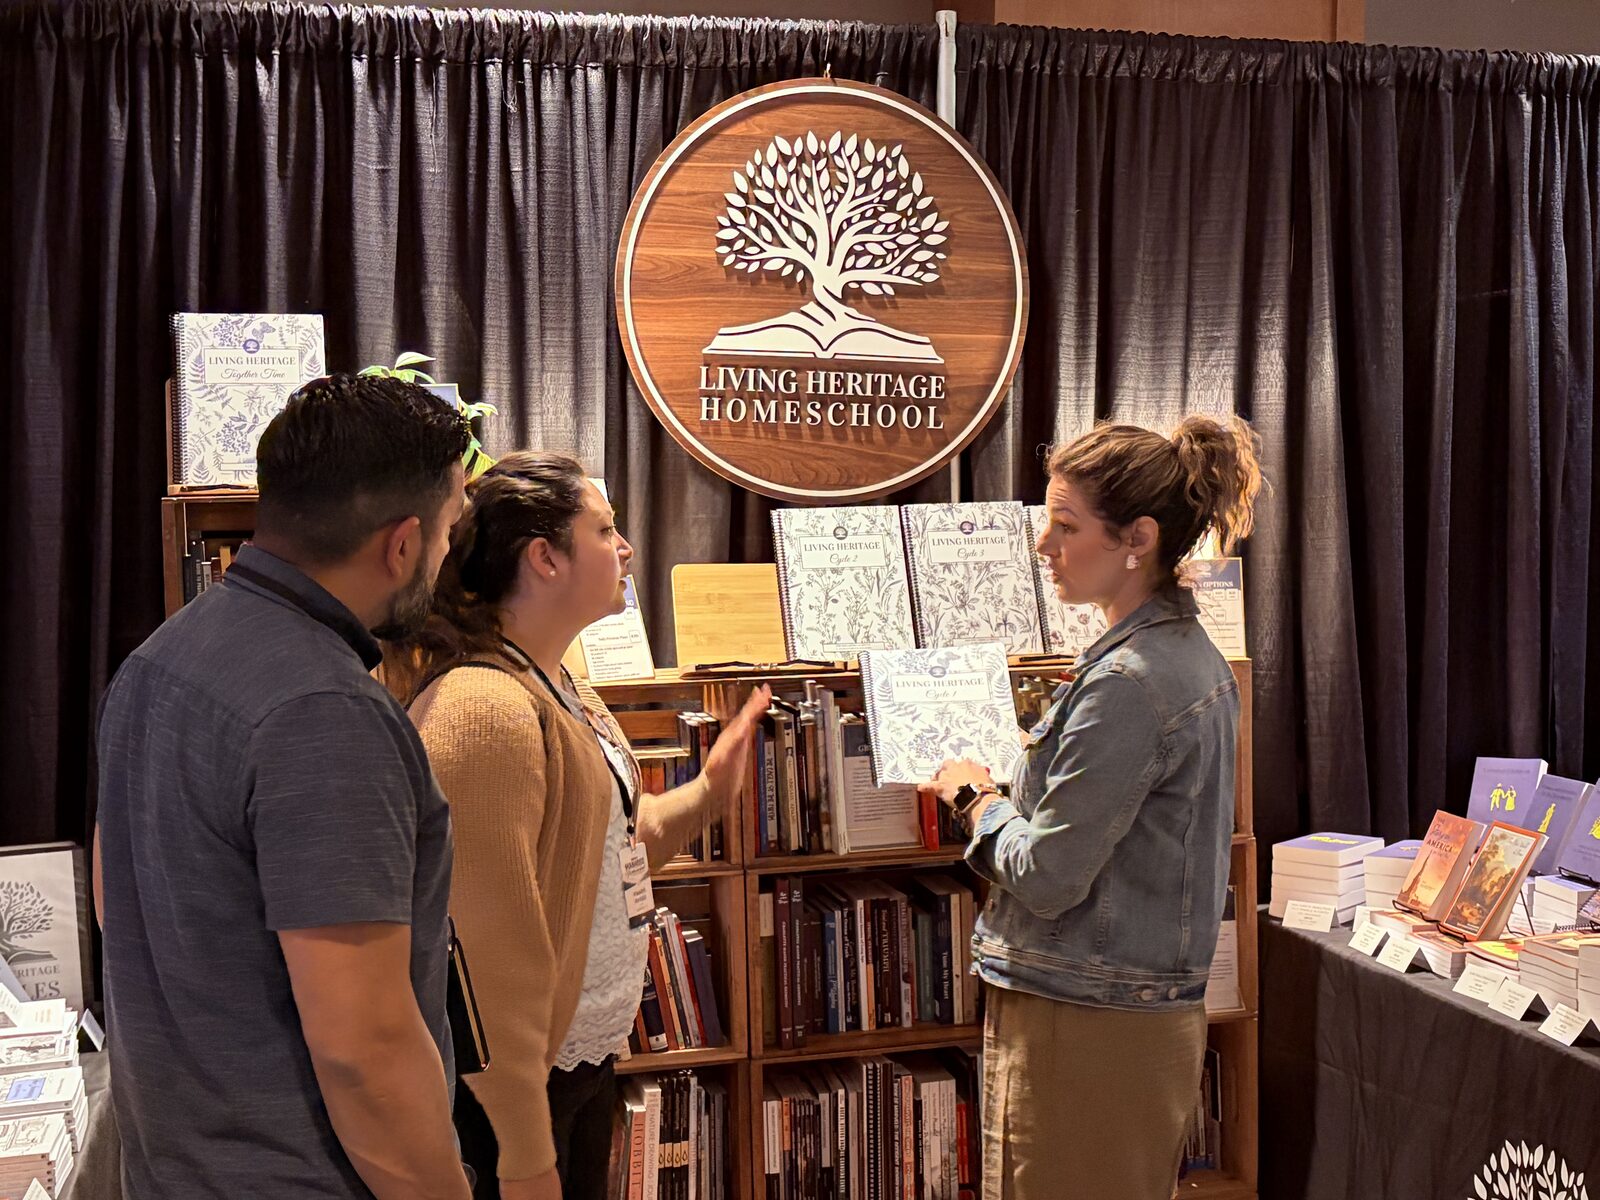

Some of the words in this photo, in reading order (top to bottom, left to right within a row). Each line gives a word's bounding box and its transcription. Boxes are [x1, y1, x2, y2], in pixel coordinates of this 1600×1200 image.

[209, 356, 244, 365] LIVING
[246, 356, 296, 365] HERITAGE
[221, 368, 258, 381] Together
[260, 368, 285, 379] Time
[699, 366, 798, 394] LIVING
[805, 370, 946, 400] HERITAGE
[699, 397, 945, 430] HOMESCHOOL
[804, 543, 835, 552] LIVING
[836, 541, 881, 551] HERITAGE
[932, 537, 962, 546] LIVING
[963, 536, 1006, 545] HERITAGE
[830, 553, 850, 566] Cycle
[957, 548, 978, 560] Cycle
[1203, 580, 1234, 588] OPTIONS
[895, 680, 931, 688] LIVING
[932, 677, 985, 687] HERITAGE
[925, 689, 949, 700] Cycle
[942, 969, 949, 979] My
[632, 1123, 644, 1188] HOBBIT
[647, 1143, 655, 1179] DRAWING
